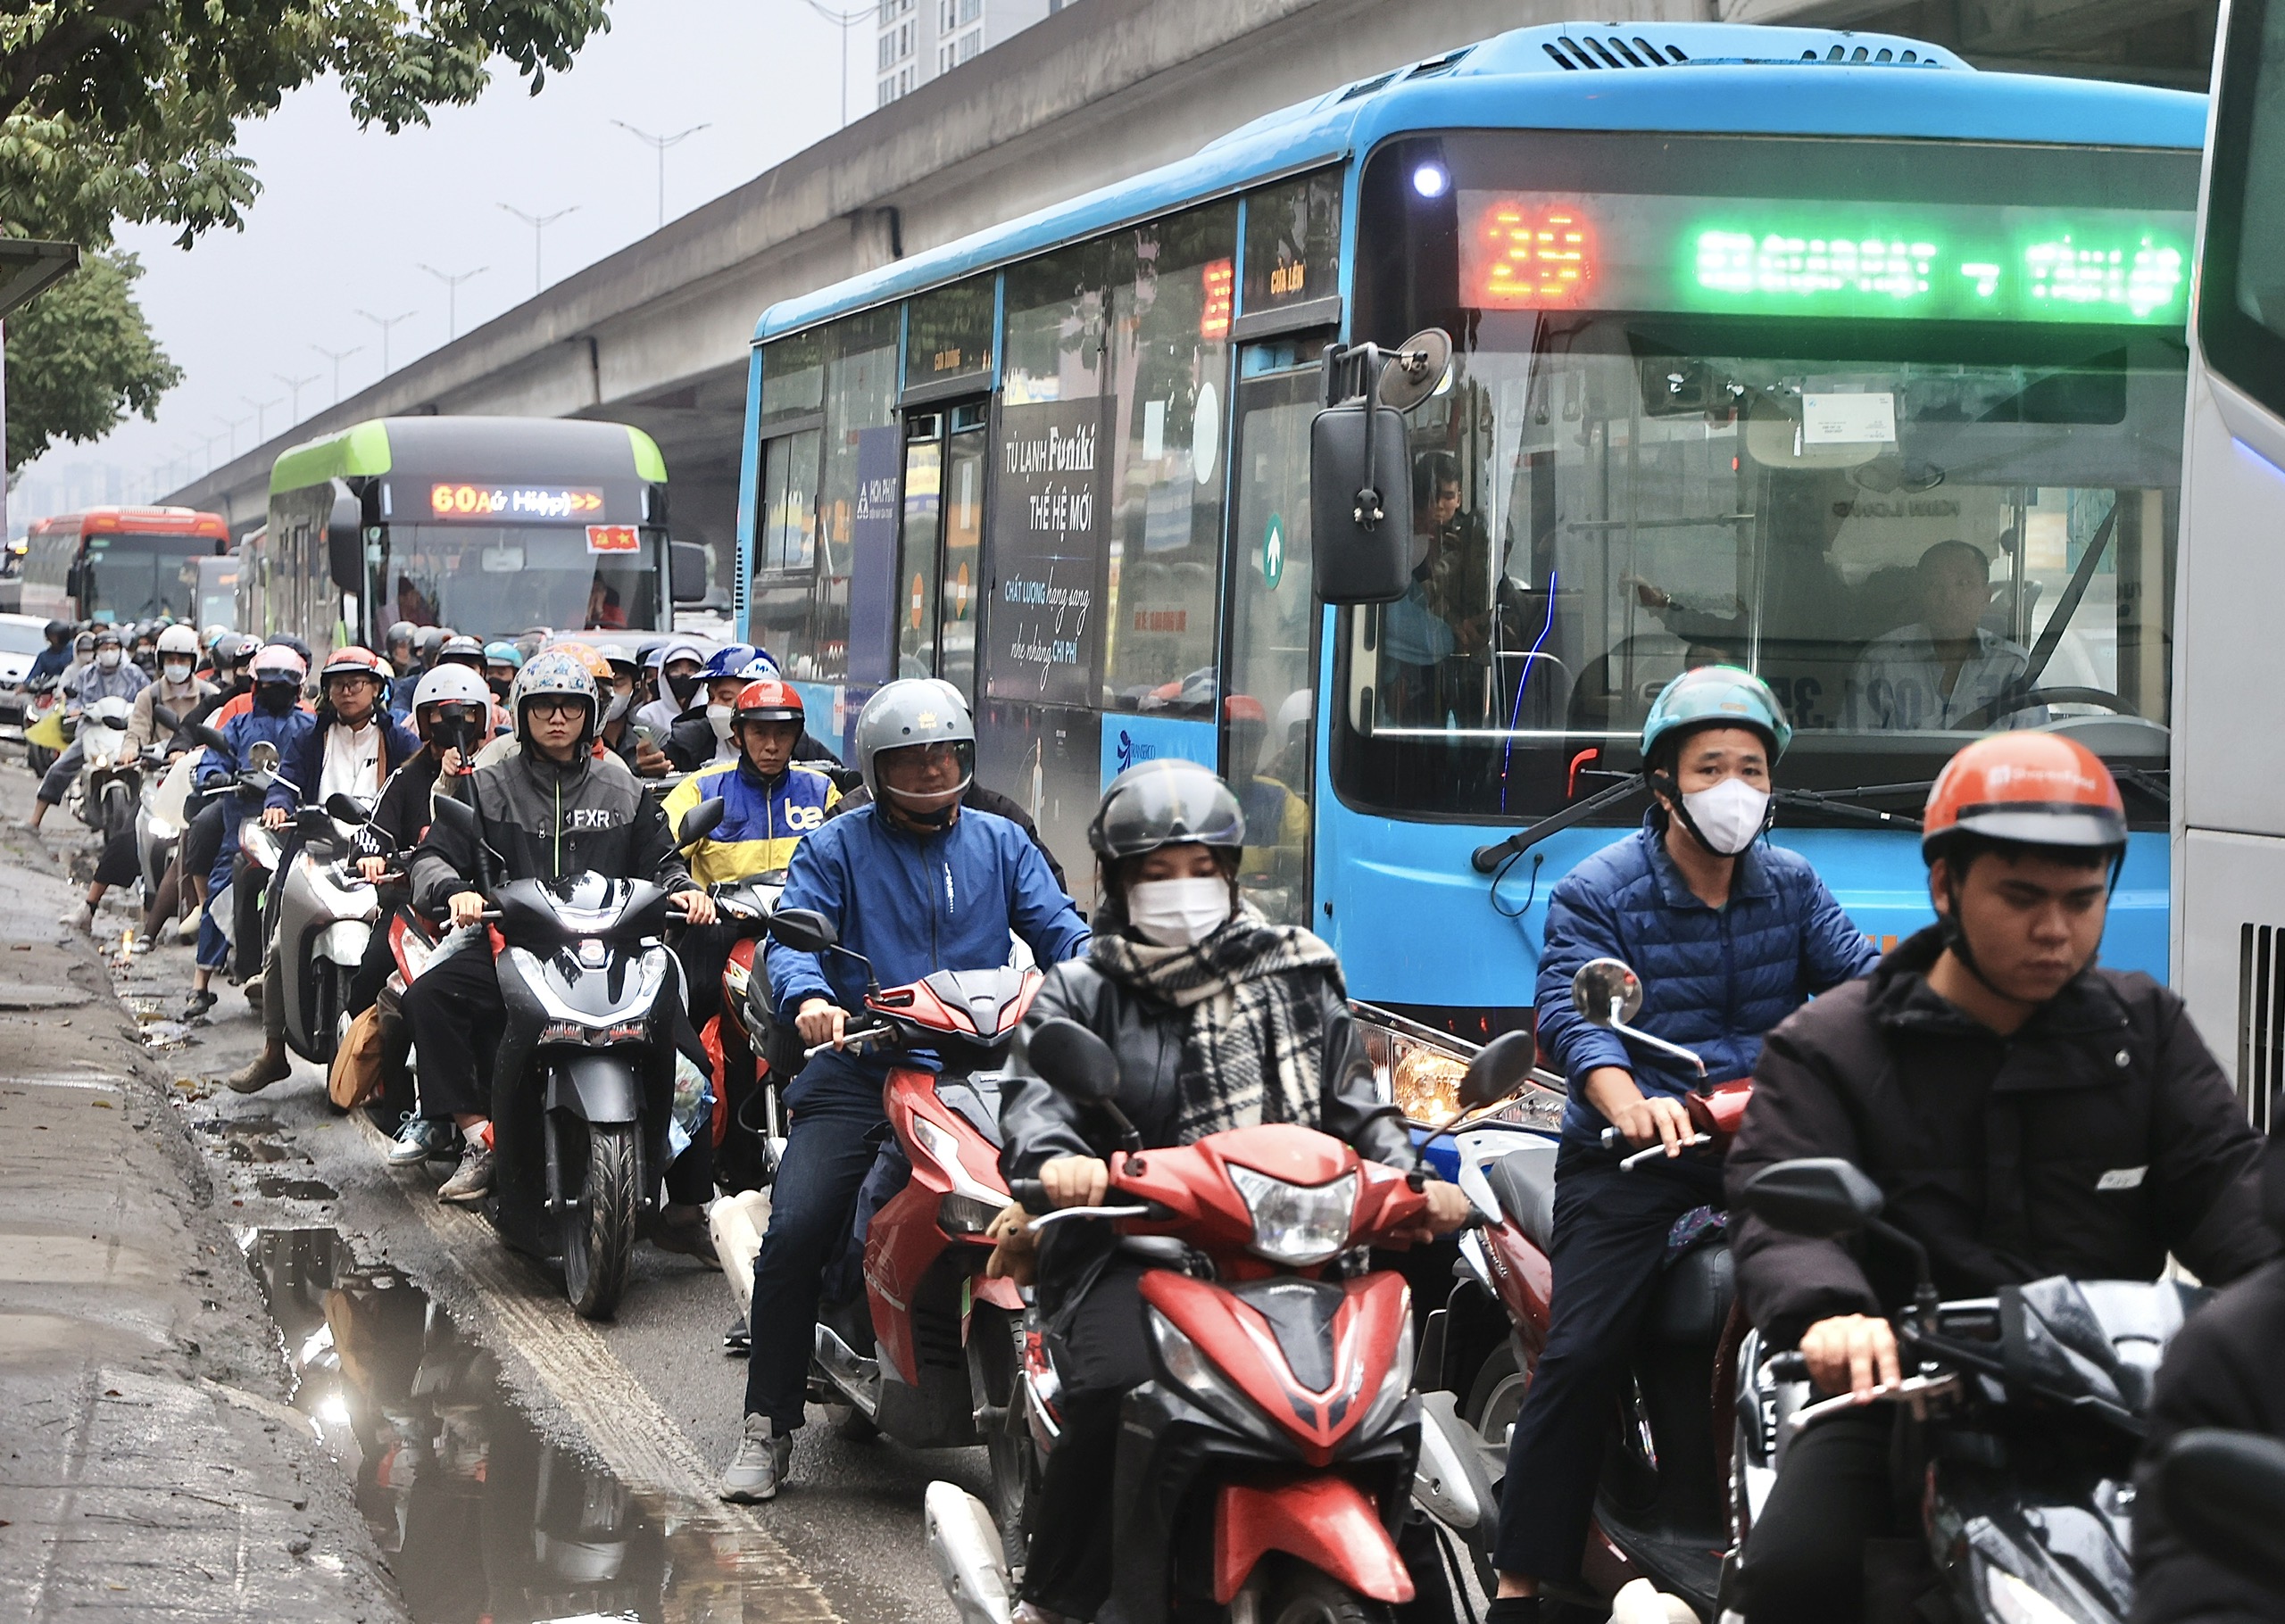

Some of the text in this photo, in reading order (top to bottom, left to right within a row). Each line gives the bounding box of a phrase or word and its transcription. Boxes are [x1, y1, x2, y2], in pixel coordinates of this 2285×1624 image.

[1006, 422, 1095, 483] TỦ LẠNH Funiki
[1030, 481, 1093, 543] THẾ HỆ MỚI
[1005, 573, 1022, 602] CHẤT
[1023, 581, 1045, 610] LƯỢNG
[1052, 639, 1064, 663] CHI
[1065, 636, 1078, 664] PHÍ
[574, 808, 610, 828] FXR
[785, 798, 824, 831] be
